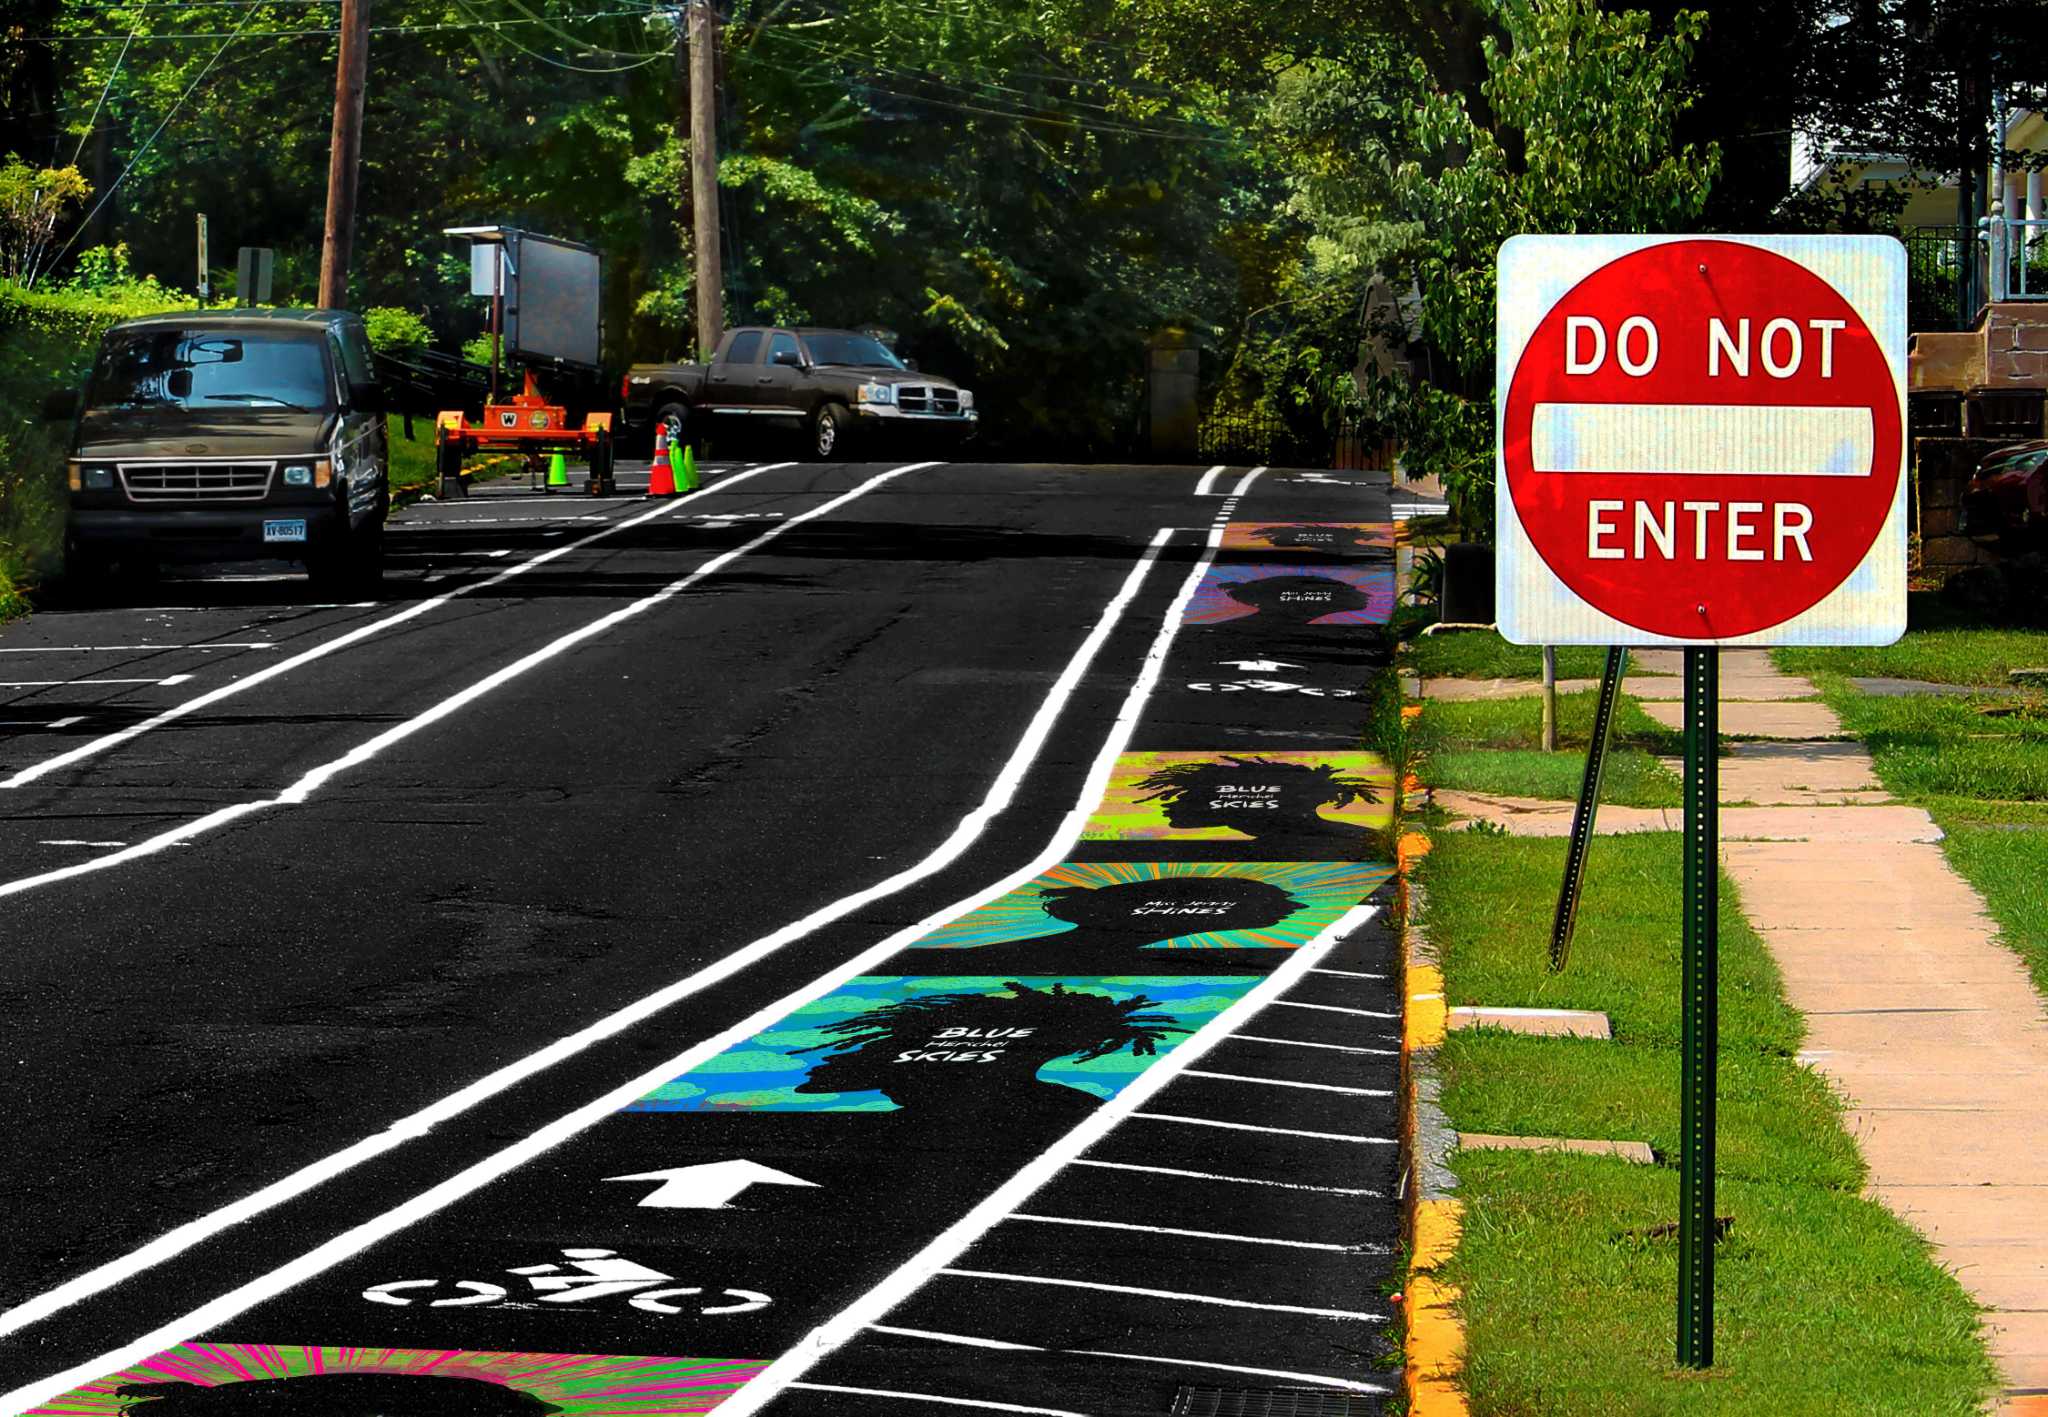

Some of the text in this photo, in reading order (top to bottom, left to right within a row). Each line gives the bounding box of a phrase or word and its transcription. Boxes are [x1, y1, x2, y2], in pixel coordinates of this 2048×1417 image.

[1565, 315, 1846, 379] DO NOT
[503, 414, 516, 425] W
[1588, 499, 1814, 561] ENTER
[1215, 784, 1281, 793] BLUE
[1208, 799, 1280, 810] SKIES
[931, 1026, 1038, 1039] BLUE
[893, 1049, 1006, 1064] SKIES
